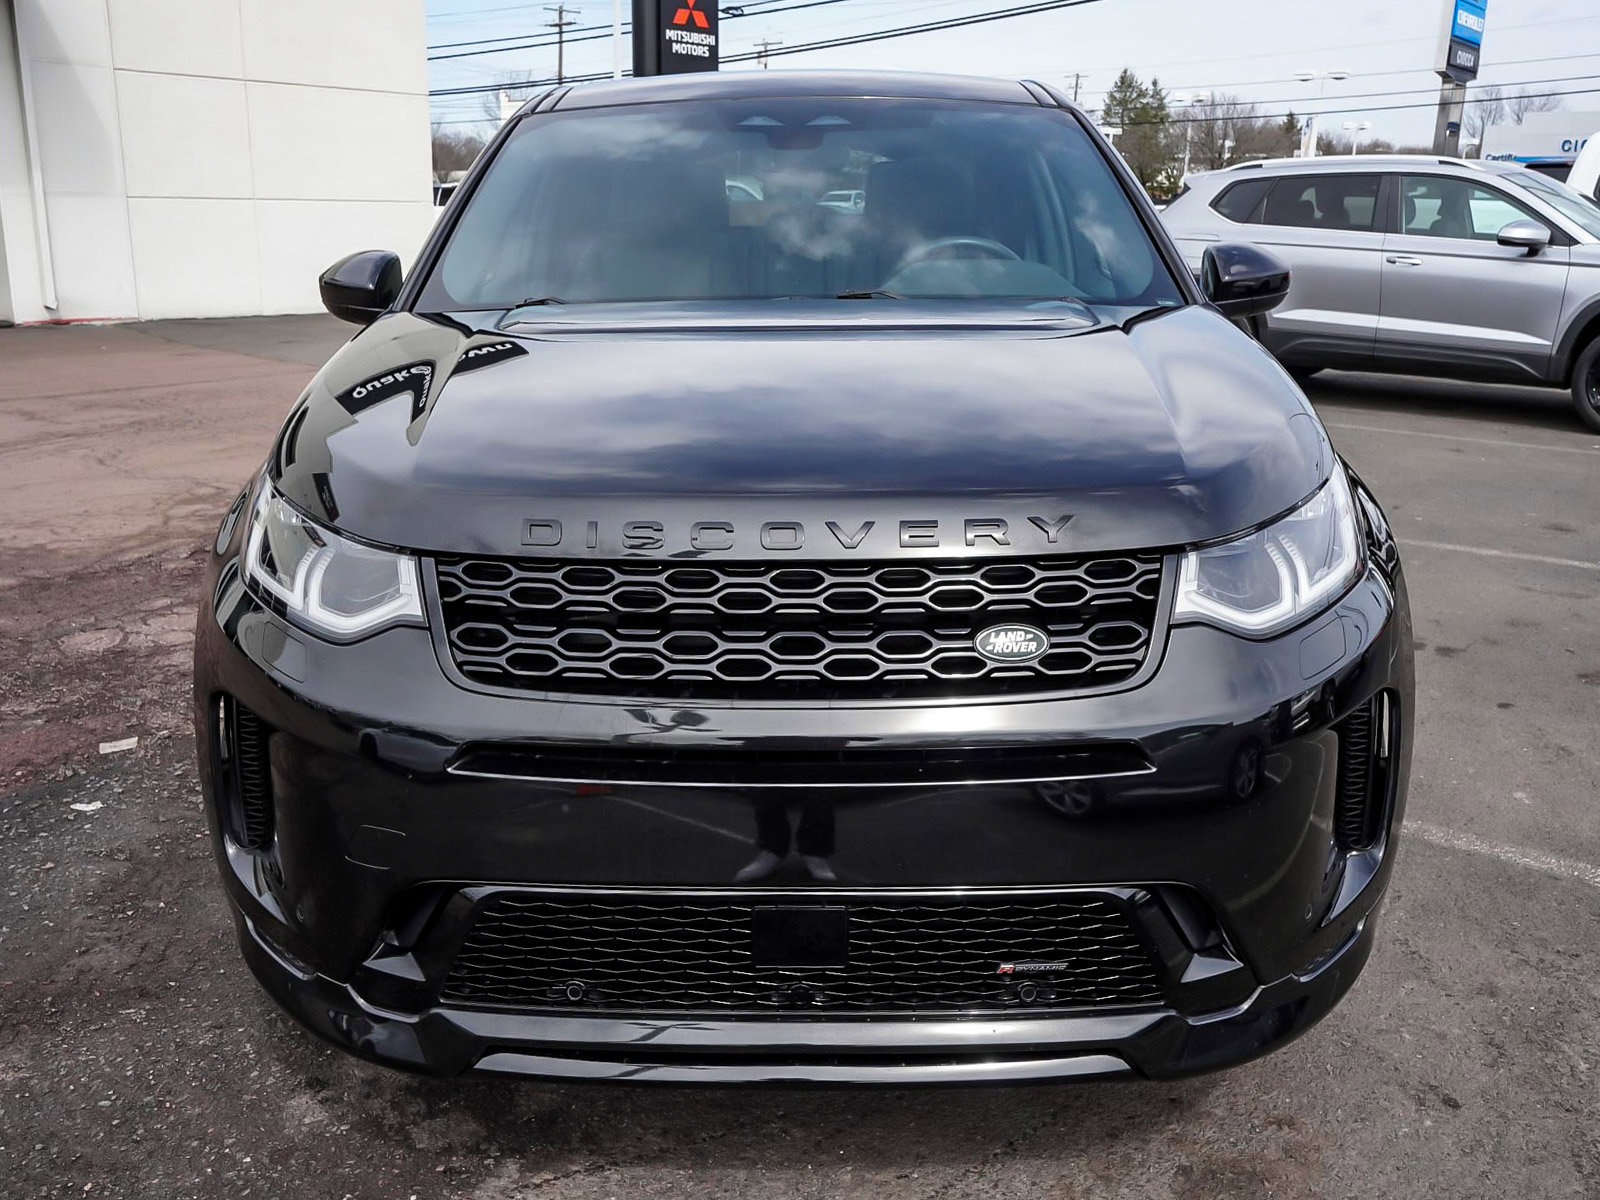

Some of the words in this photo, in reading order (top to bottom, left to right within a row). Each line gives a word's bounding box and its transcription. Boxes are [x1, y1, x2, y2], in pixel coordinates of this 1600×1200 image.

[665, 29, 716, 46] MITSUBISHI
[672, 42, 709, 58] MOTORS
[521, 515, 1075, 550] DISCOVERY
[989, 630, 1025, 643] LAND
[993, 641, 1037, 653] ROVER
